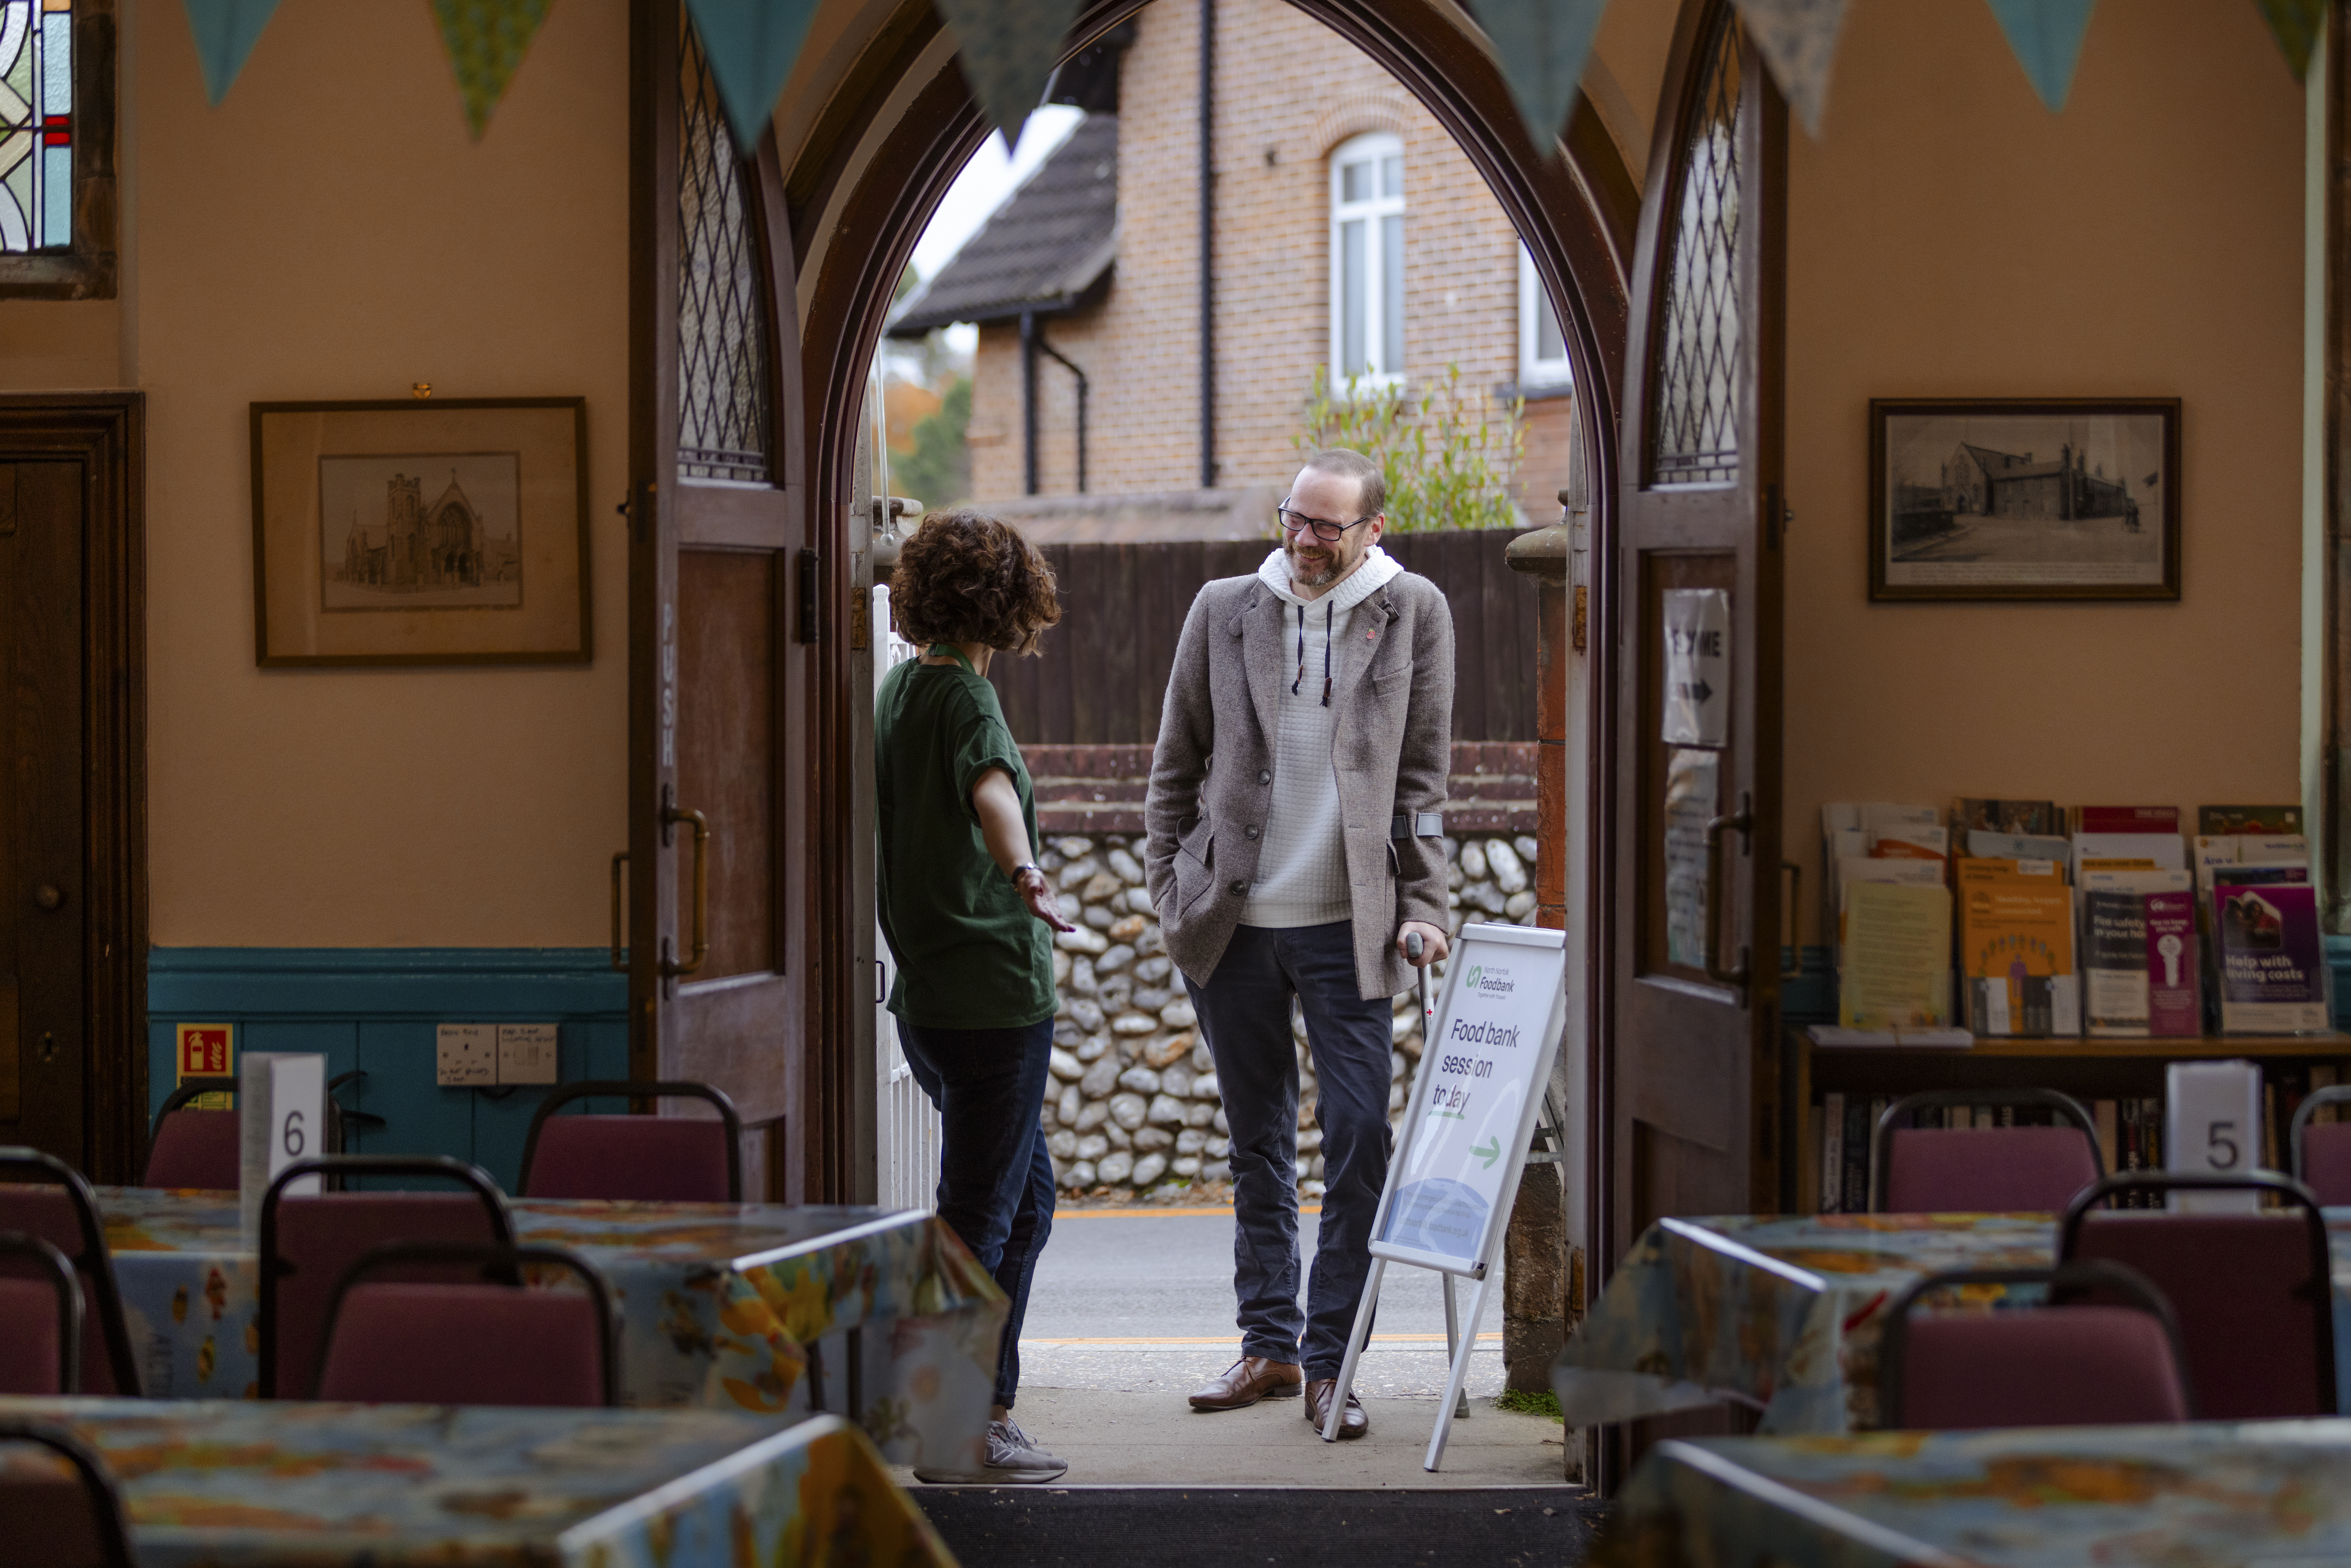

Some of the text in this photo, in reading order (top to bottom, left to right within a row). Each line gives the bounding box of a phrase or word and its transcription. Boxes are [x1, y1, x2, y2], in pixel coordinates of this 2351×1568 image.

[662, 603, 673, 767] PUSH
[2093, 915, 2145, 928] Fire safety
[2105, 929, 2127, 939] your
[2225, 954, 2293, 970] Help with
[1495, 968, 1510, 976] Norfolk
[2226, 968, 2304, 983] living costs
[1480, 976, 1514, 993] Foodbank
[1450, 1018, 1521, 1048] Food bank
[1441, 1053, 1493, 1078] session
[1433, 1084, 1471, 1116] today
[284, 1109, 306, 1158] 6
[2206, 1120, 2239, 1170] 5
[1419, 1203, 1441, 1214] experiencing
[1420, 1194, 1439, 1204] emergency
[1454, 1201, 1469, 1209] practical
[1397, 1216, 1470, 1239] northnorfolk.foodbank.org.uk
